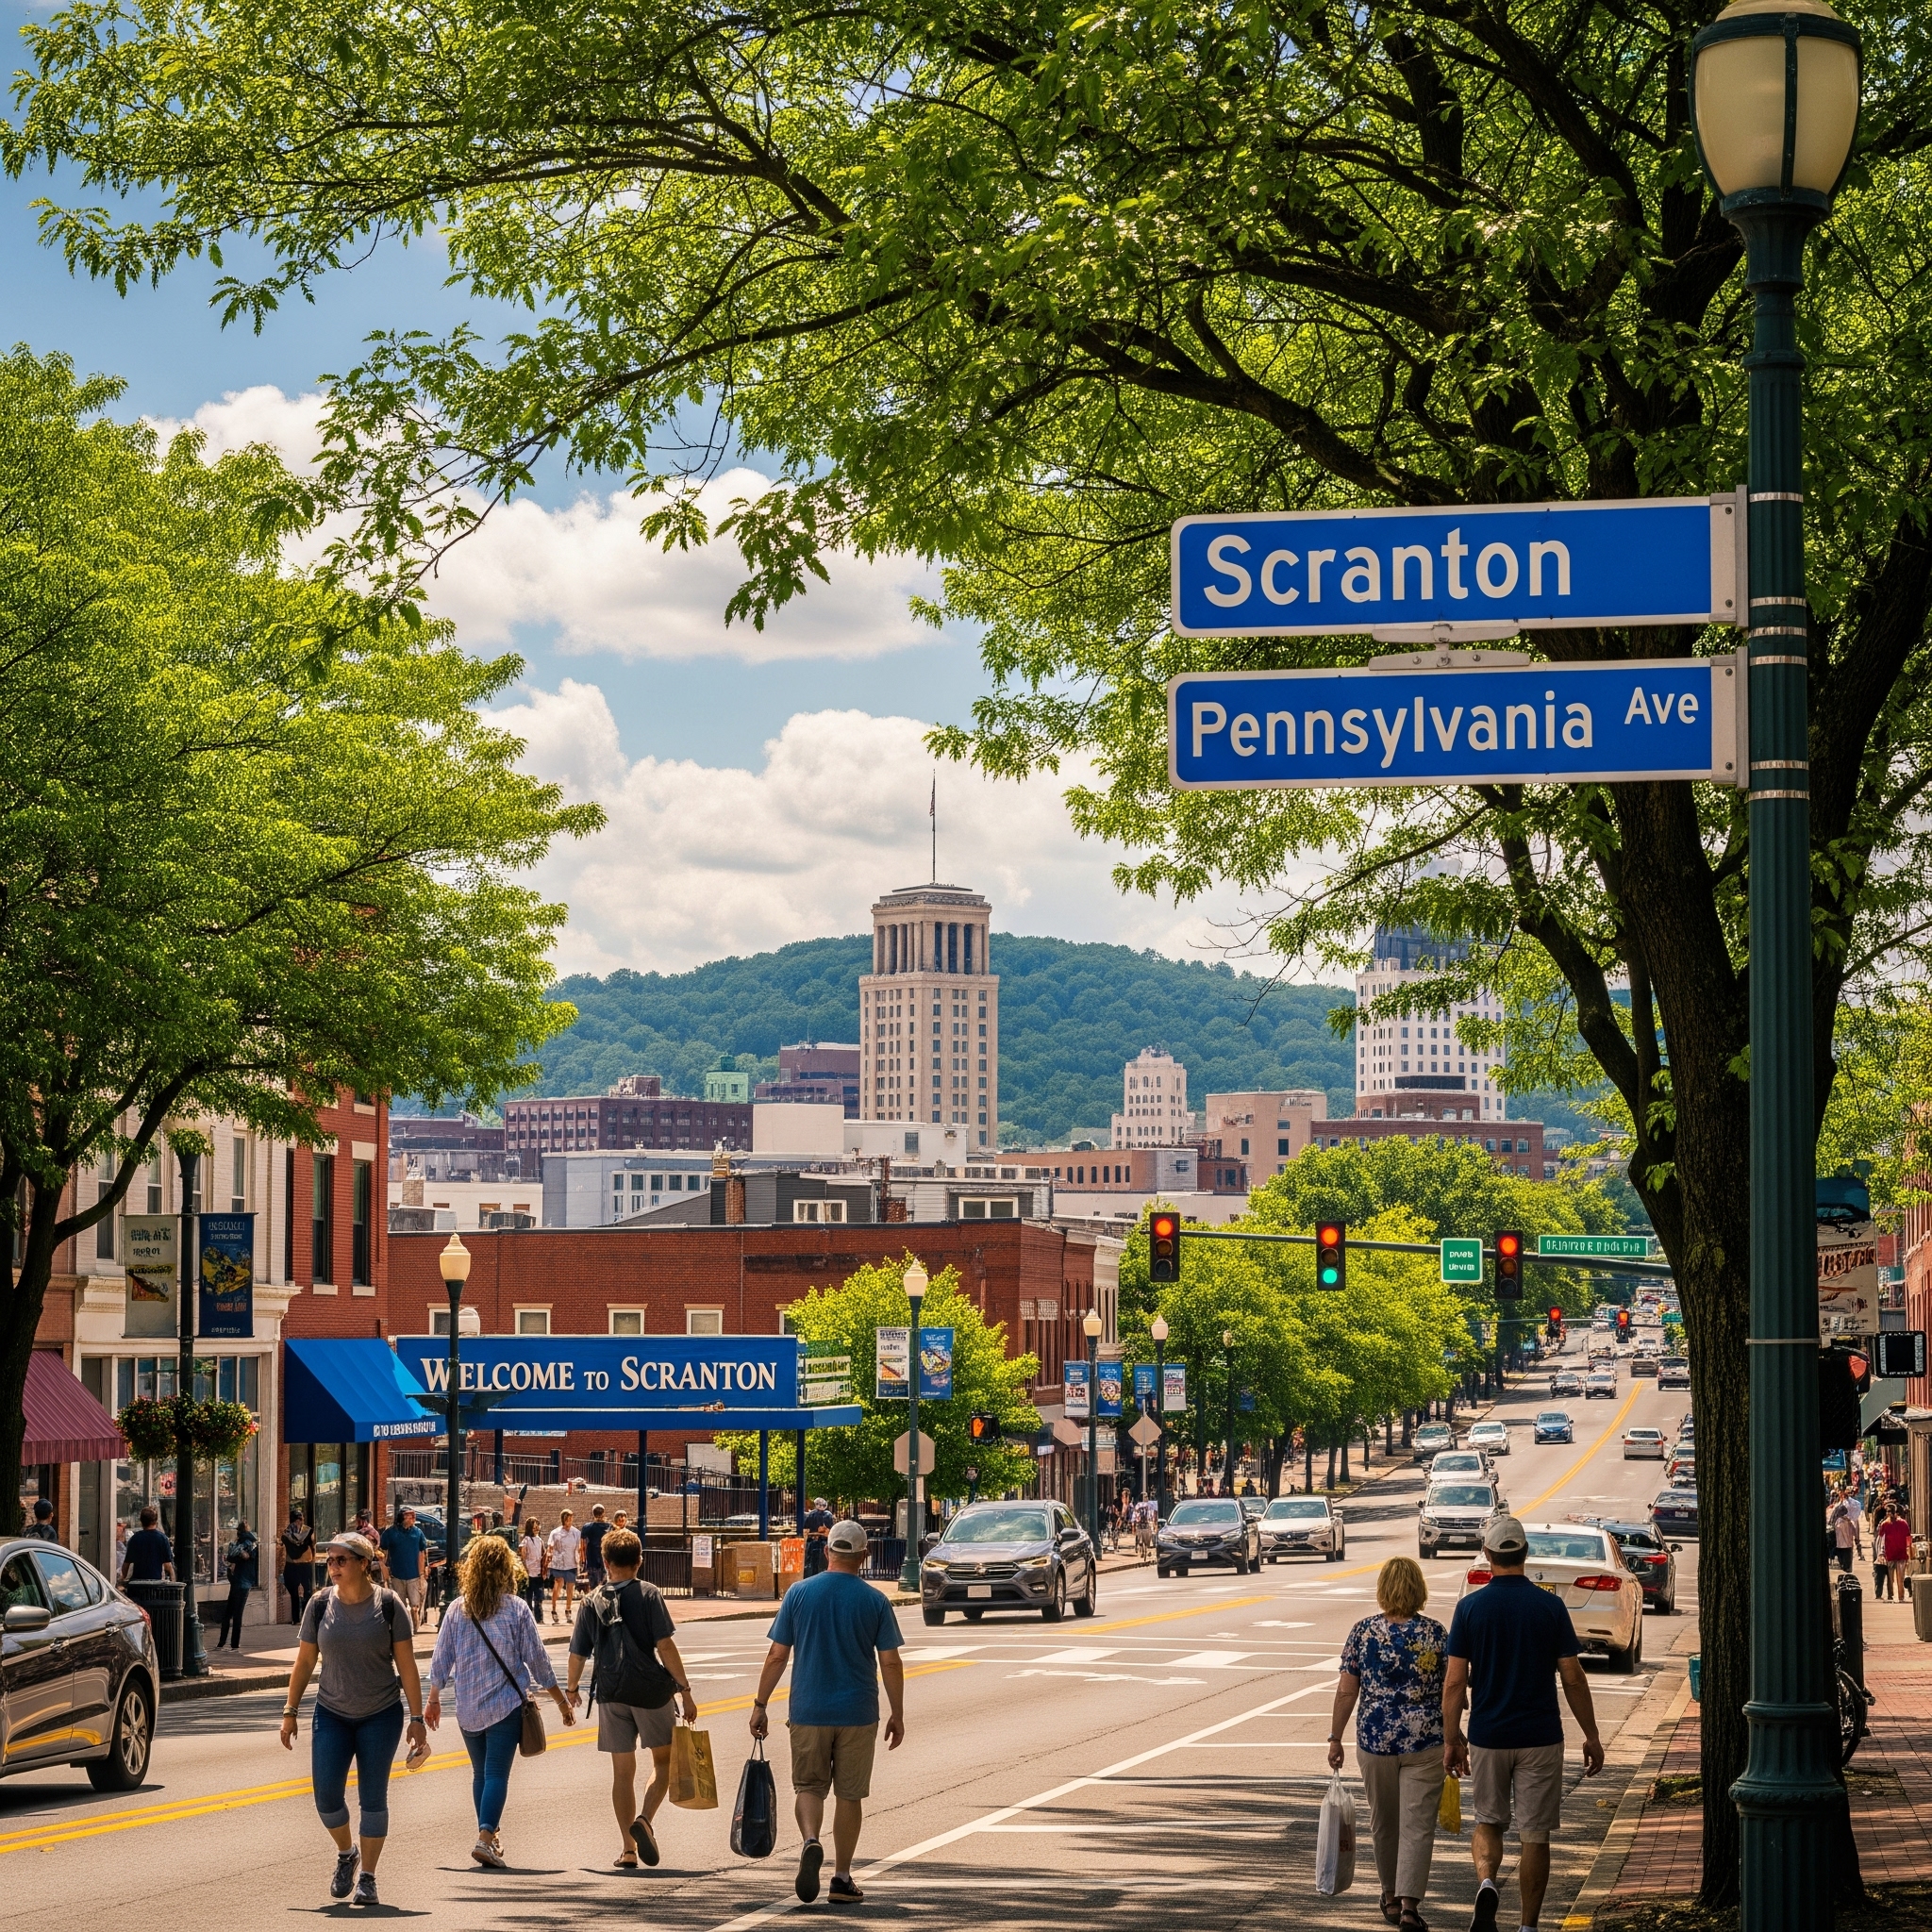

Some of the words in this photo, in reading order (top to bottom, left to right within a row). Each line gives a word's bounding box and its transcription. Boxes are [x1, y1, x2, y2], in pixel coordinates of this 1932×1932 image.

[1203, 526, 1571, 608] Scranton
[1191, 691, 1593, 769] Pennsylvania
[1624, 686, 1699, 725] Ave
[420, 1357, 575, 1391] WELCOME
[584, 1371, 609, 1391] TO
[621, 1356, 776, 1391] SCRANTON
